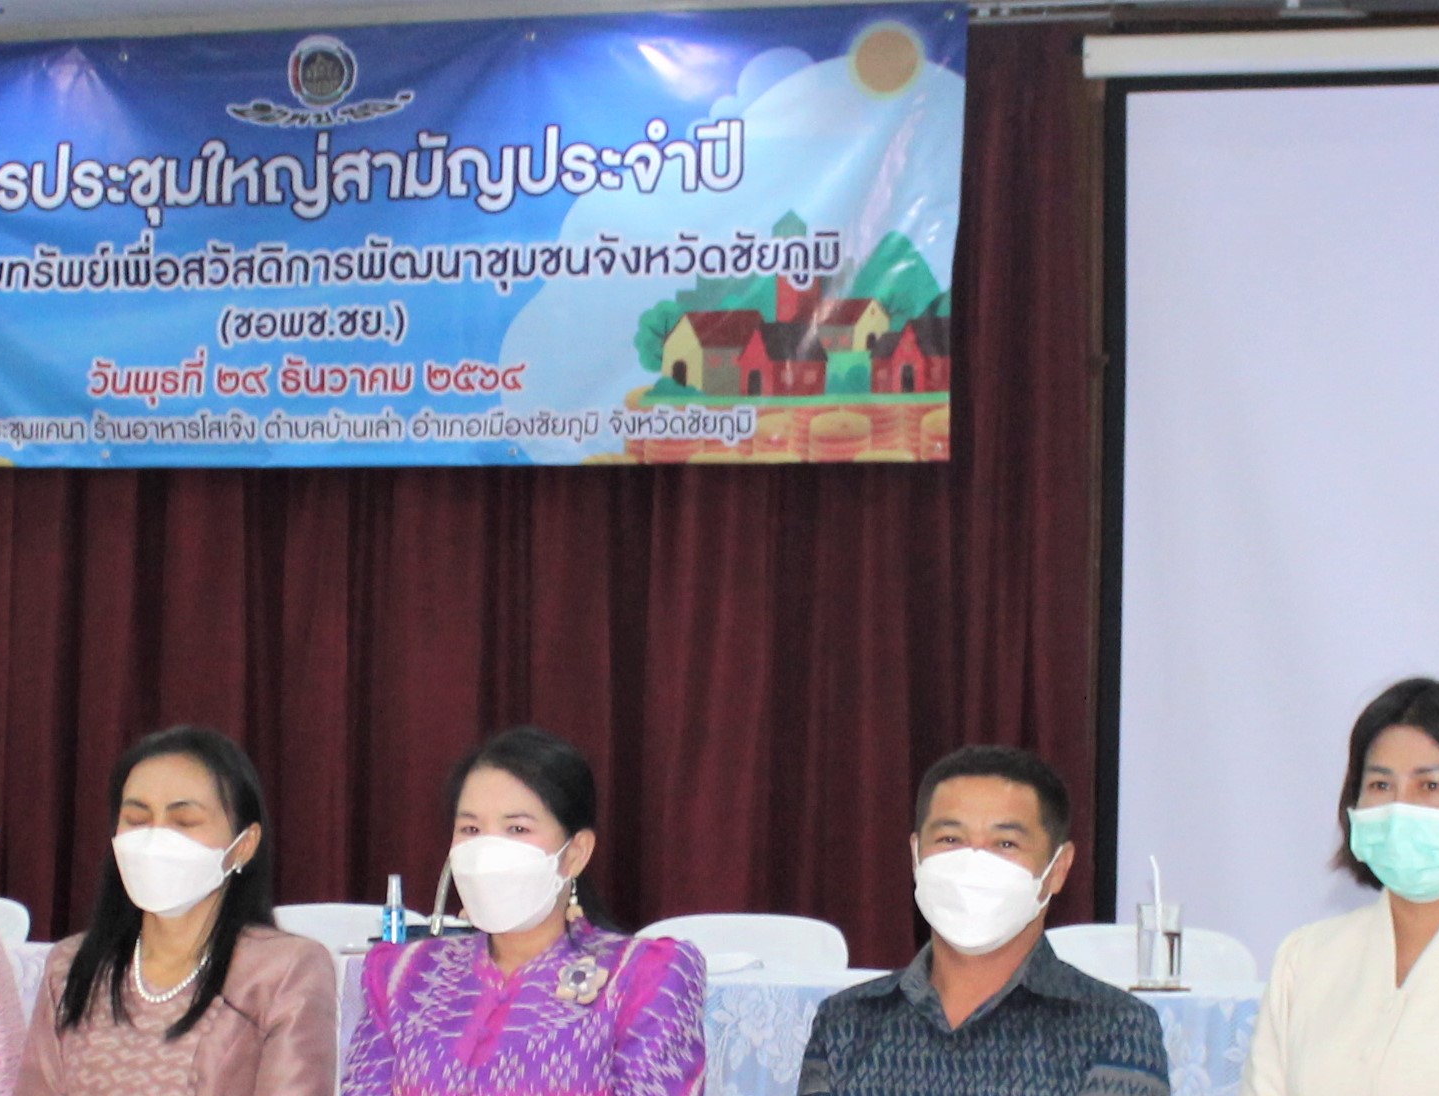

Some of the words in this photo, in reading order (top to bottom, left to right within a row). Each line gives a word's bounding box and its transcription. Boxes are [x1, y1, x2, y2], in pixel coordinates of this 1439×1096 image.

[220, 306, 406, 344] (ชอพช.ชย.)
[90, 349, 206, 406] วันพุธที่
[217, 366, 269, 395] ๒๙
[280, 359, 411, 394] ธันวาคม
[426, 362, 526, 394] ๒๕๖๔
[609, 409, 752, 442] จังหวัดชัยภูมิ
